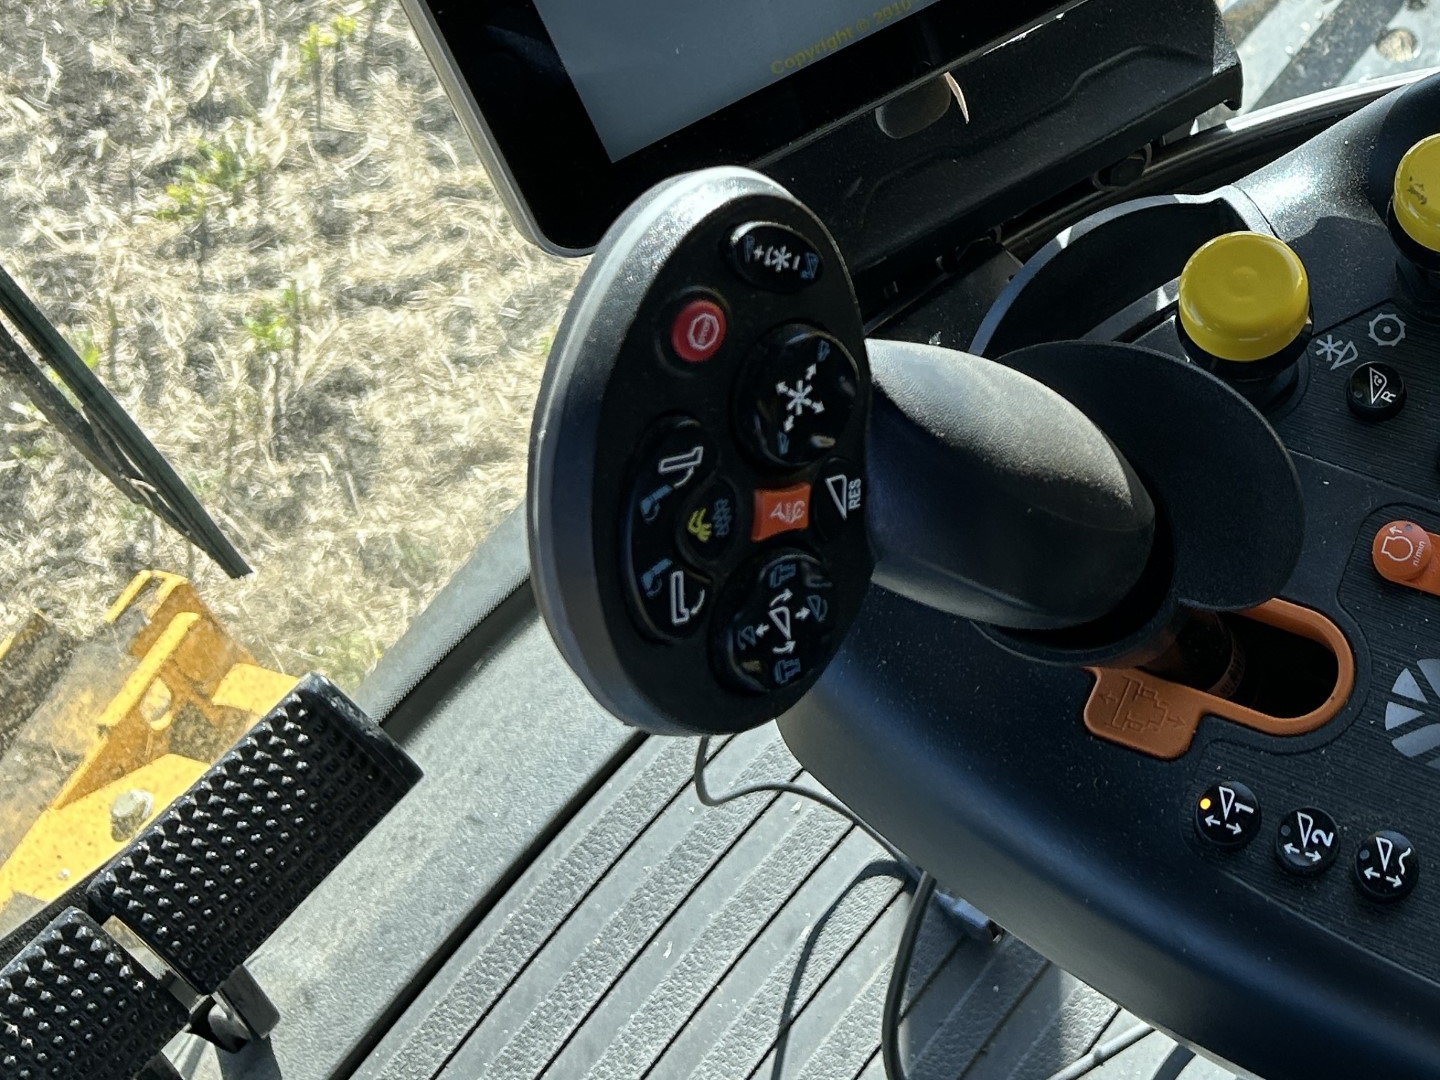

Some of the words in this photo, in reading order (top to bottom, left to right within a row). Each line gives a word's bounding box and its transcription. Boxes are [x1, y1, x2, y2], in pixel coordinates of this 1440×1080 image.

[769, 23, 854, 75] Copyright
[1381, 390, 1397, 403] R
[847, 478, 862, 510] RES
[1412, 540, 1427, 567] n/min
[1234, 802, 1254, 814] 1
[1311, 829, 1334, 847] 2
